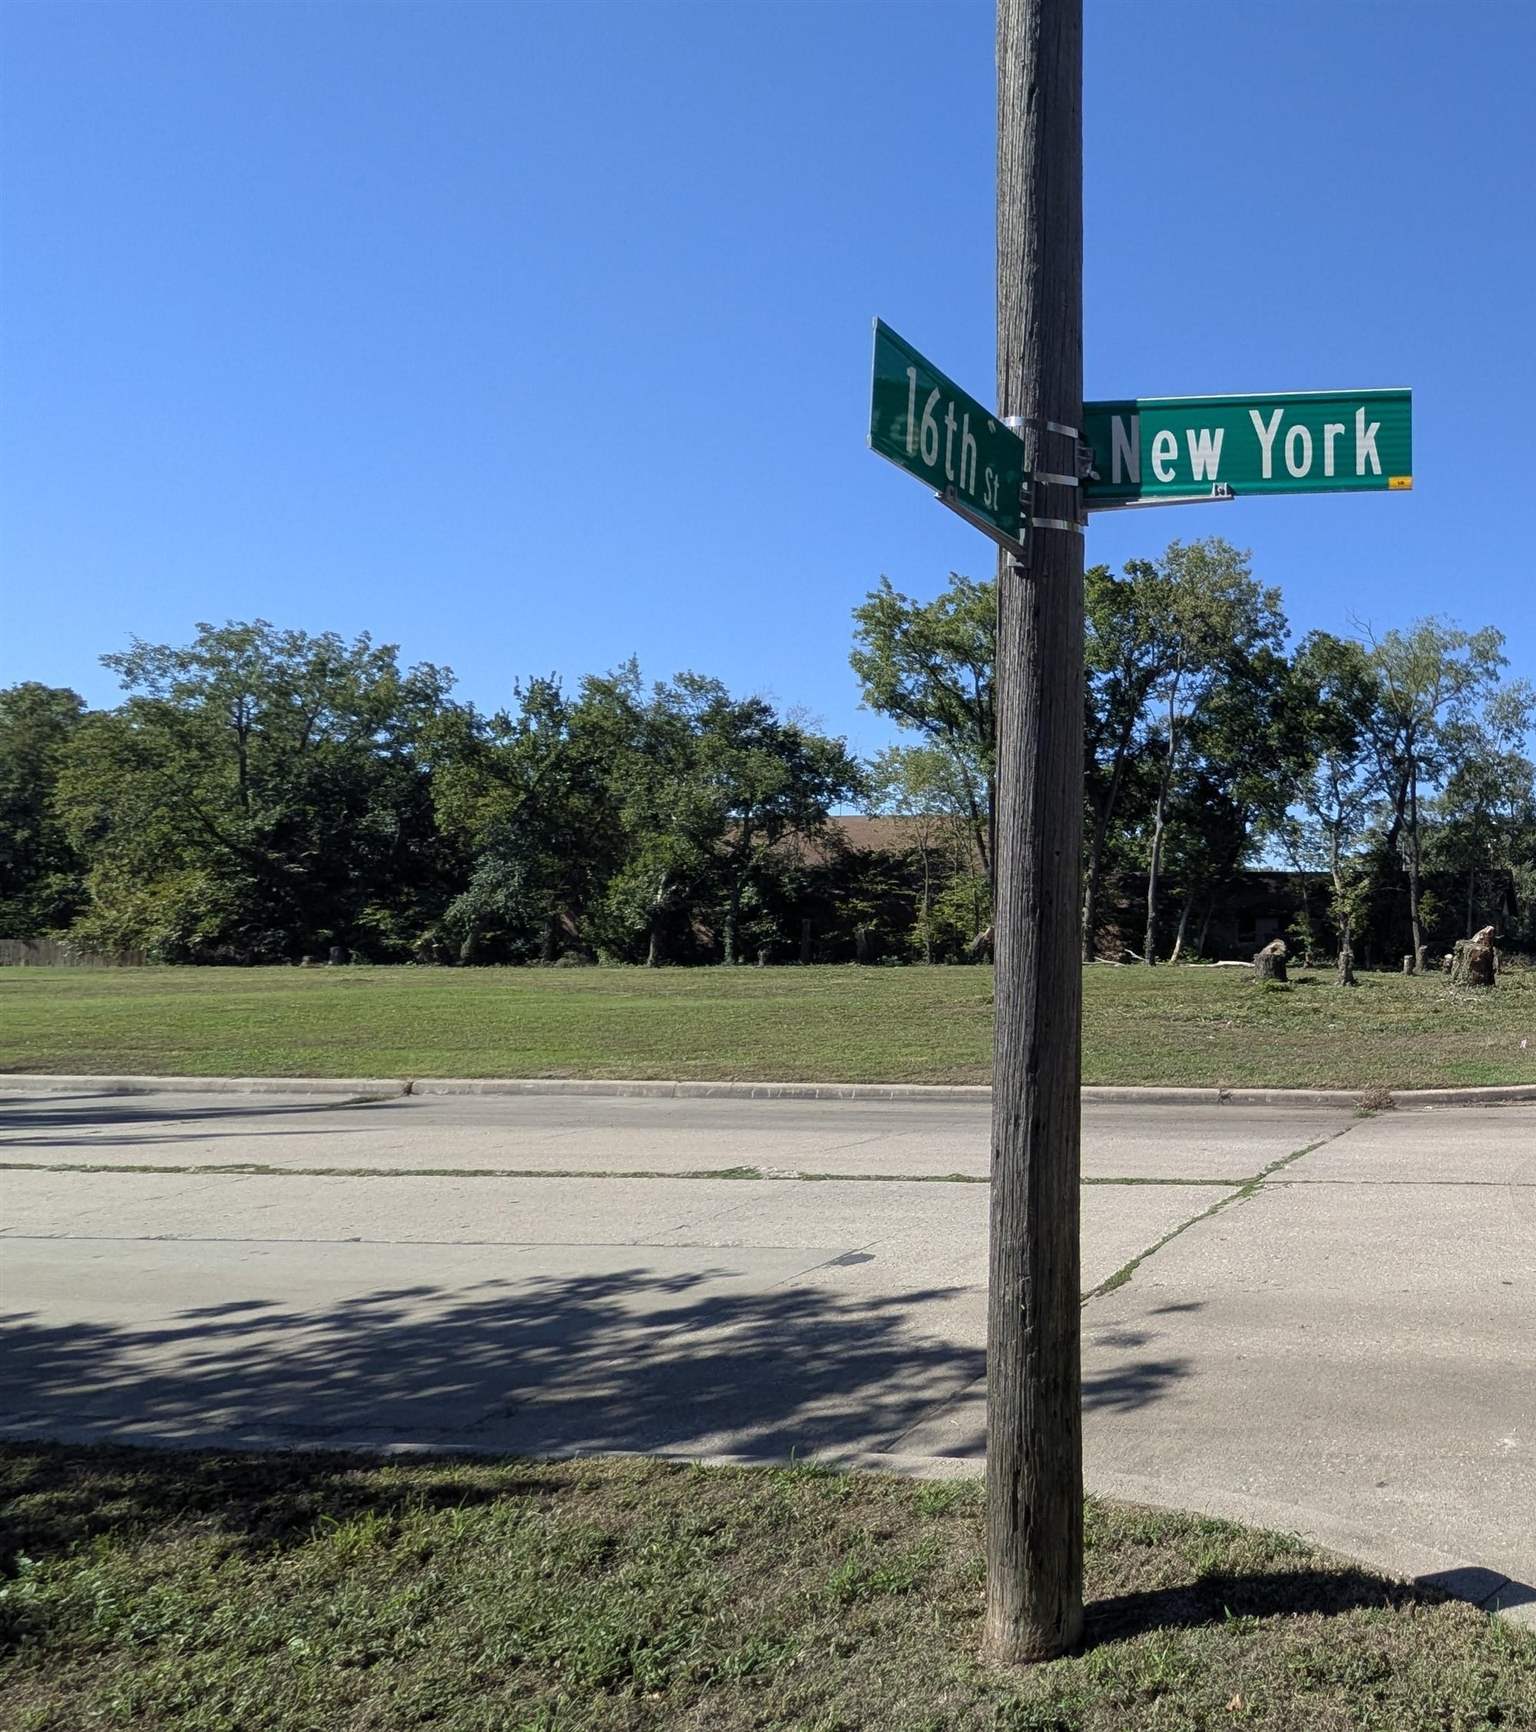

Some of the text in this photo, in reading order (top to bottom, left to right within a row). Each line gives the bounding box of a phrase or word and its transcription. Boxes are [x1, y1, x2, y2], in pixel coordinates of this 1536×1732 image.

[906, 366, 1000, 511] 16th St
[1111, 406, 1383, 484] New York
